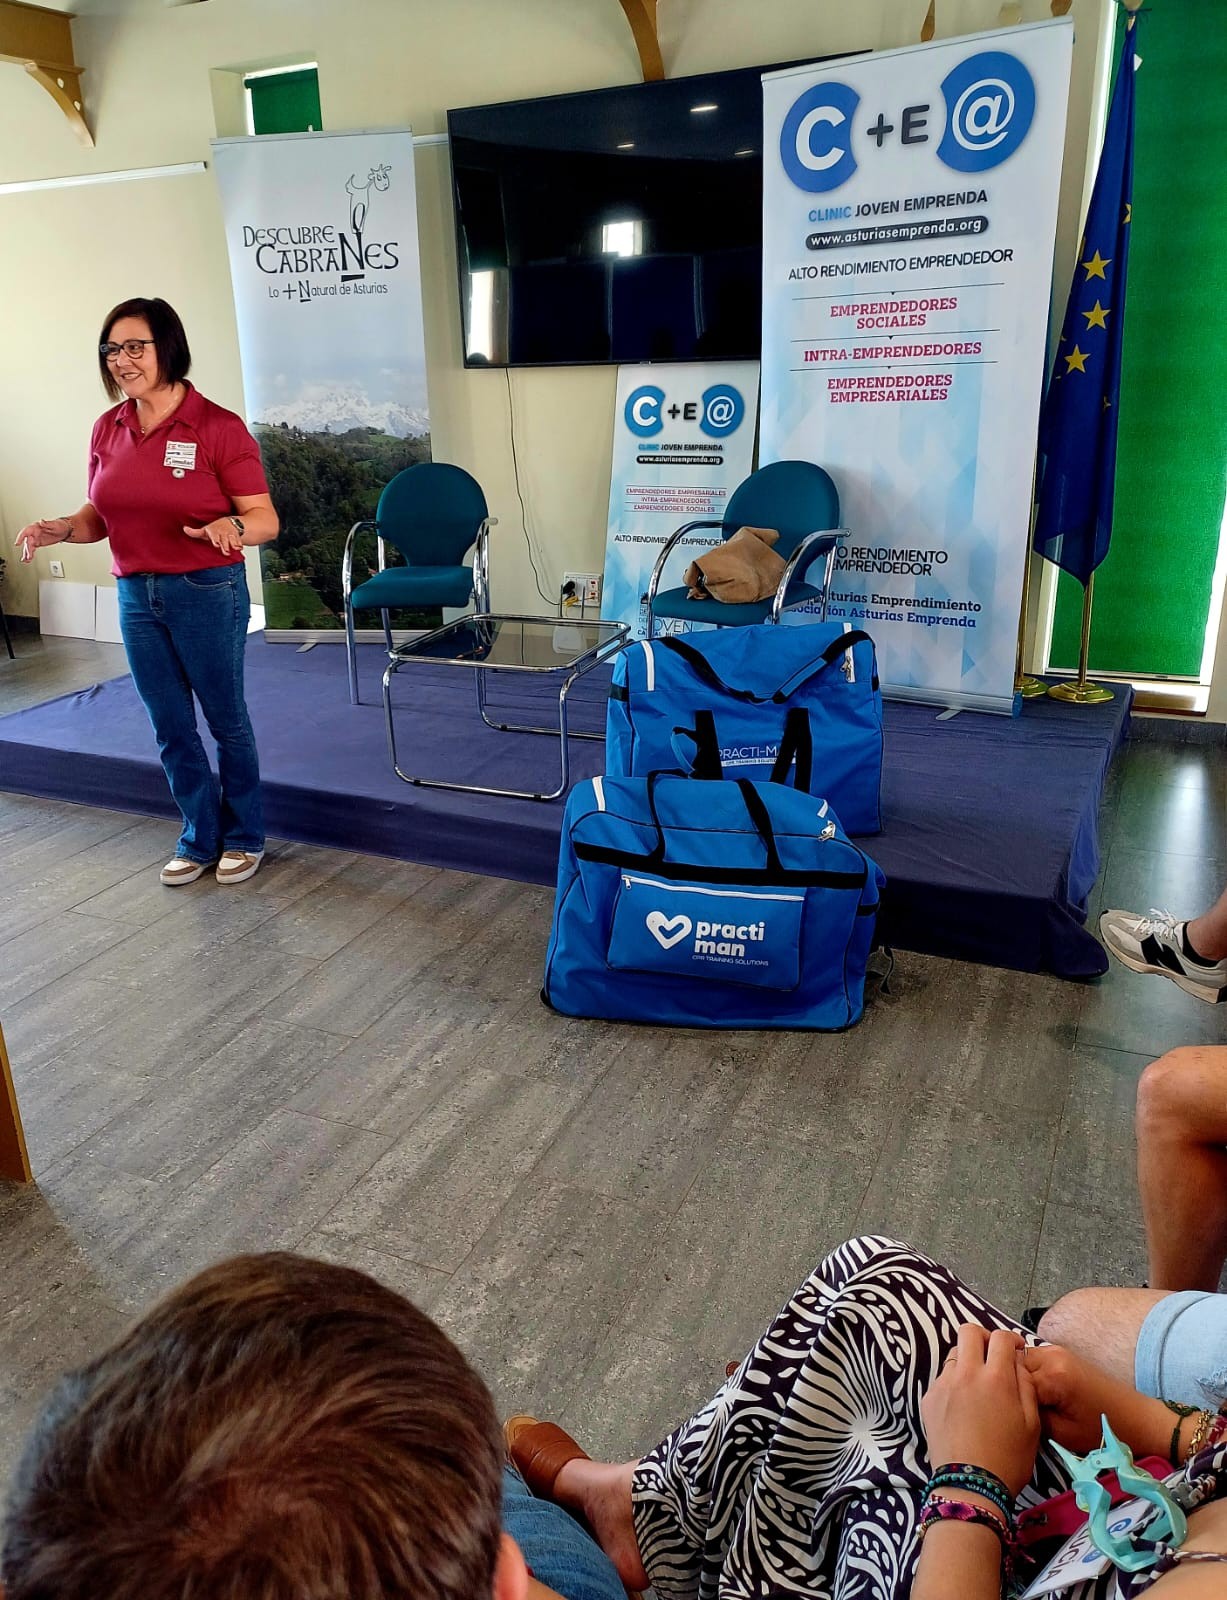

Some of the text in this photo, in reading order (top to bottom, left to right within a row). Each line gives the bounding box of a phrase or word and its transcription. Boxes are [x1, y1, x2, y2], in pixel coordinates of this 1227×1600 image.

[808, 189, 988, 222] CLINIC JOVEN EMPRENDA
[811, 218, 982, 245] www.asturiasemprenda.org
[788, 249, 1014, 280] ALTO RENDIMIENTO EMPRENDEDOR
[268, 286, 279, 298] Lo
[339, 283, 351, 295] de
[353, 282, 388, 295] Asturias
[830, 297, 958, 317] EMPRENDEDORES
[857, 314, 926, 329] SOCIALES
[803, 342, 982, 362] INTRA-EMPRENDEDORES
[827, 374, 952, 390] EMPRENDEDORES
[830, 389, 948, 403] EMPRESARIALES
[684, 444, 723, 452] EMPRENDA
[677, 488, 726, 496] EMPRESARIALES
[633, 536, 680, 545] RENDIMIENO
[851, 547, 948, 564] RENDIMIENTO
[871, 594, 982, 612] Emprendimiento
[849, 608, 904, 622] Asturias
[907, 612, 976, 628] Emprenda
[696, 921, 766, 941] practi
[694, 939, 745, 957] man
[706, 956, 734, 964] TRAINING
[735, 958, 769, 967] SOLUTIONS
